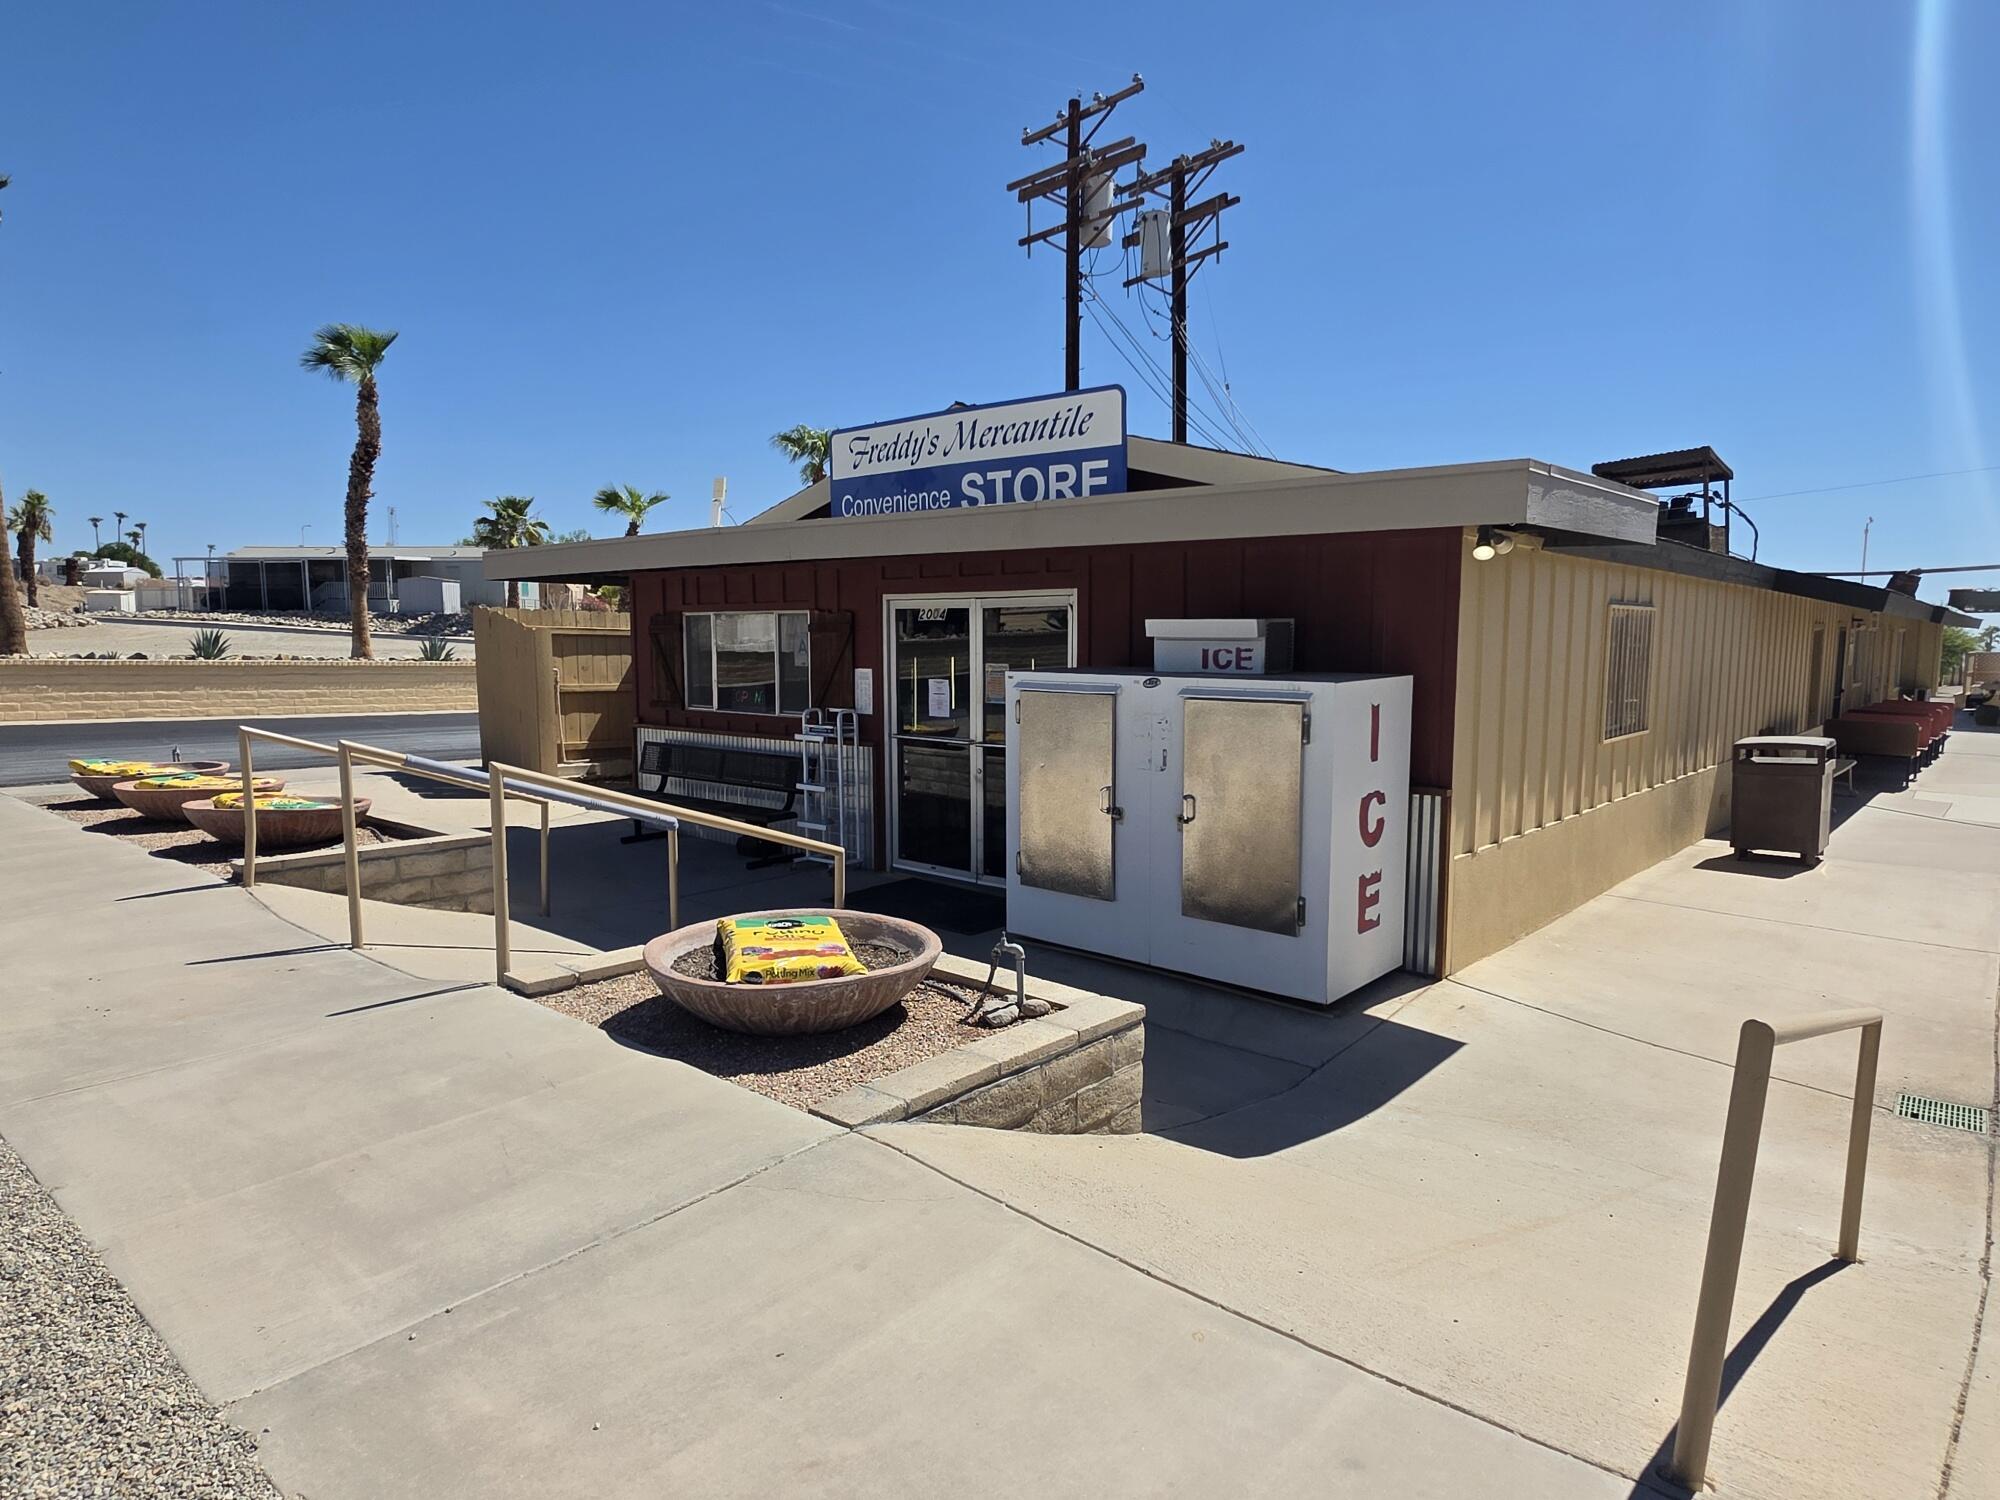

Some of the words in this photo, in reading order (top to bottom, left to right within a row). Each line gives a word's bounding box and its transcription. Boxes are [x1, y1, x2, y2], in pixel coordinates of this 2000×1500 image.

[848, 427, 940, 470] Freddy's
[942, 404, 1095, 457] Mercantile
[841, 488, 951, 518] Convenience
[960, 459, 1109, 508] STORE
[919, 608, 946, 620] 2004
[1201, 647, 1255, 671] ICE
[1357, 703, 1387, 935] ICE
